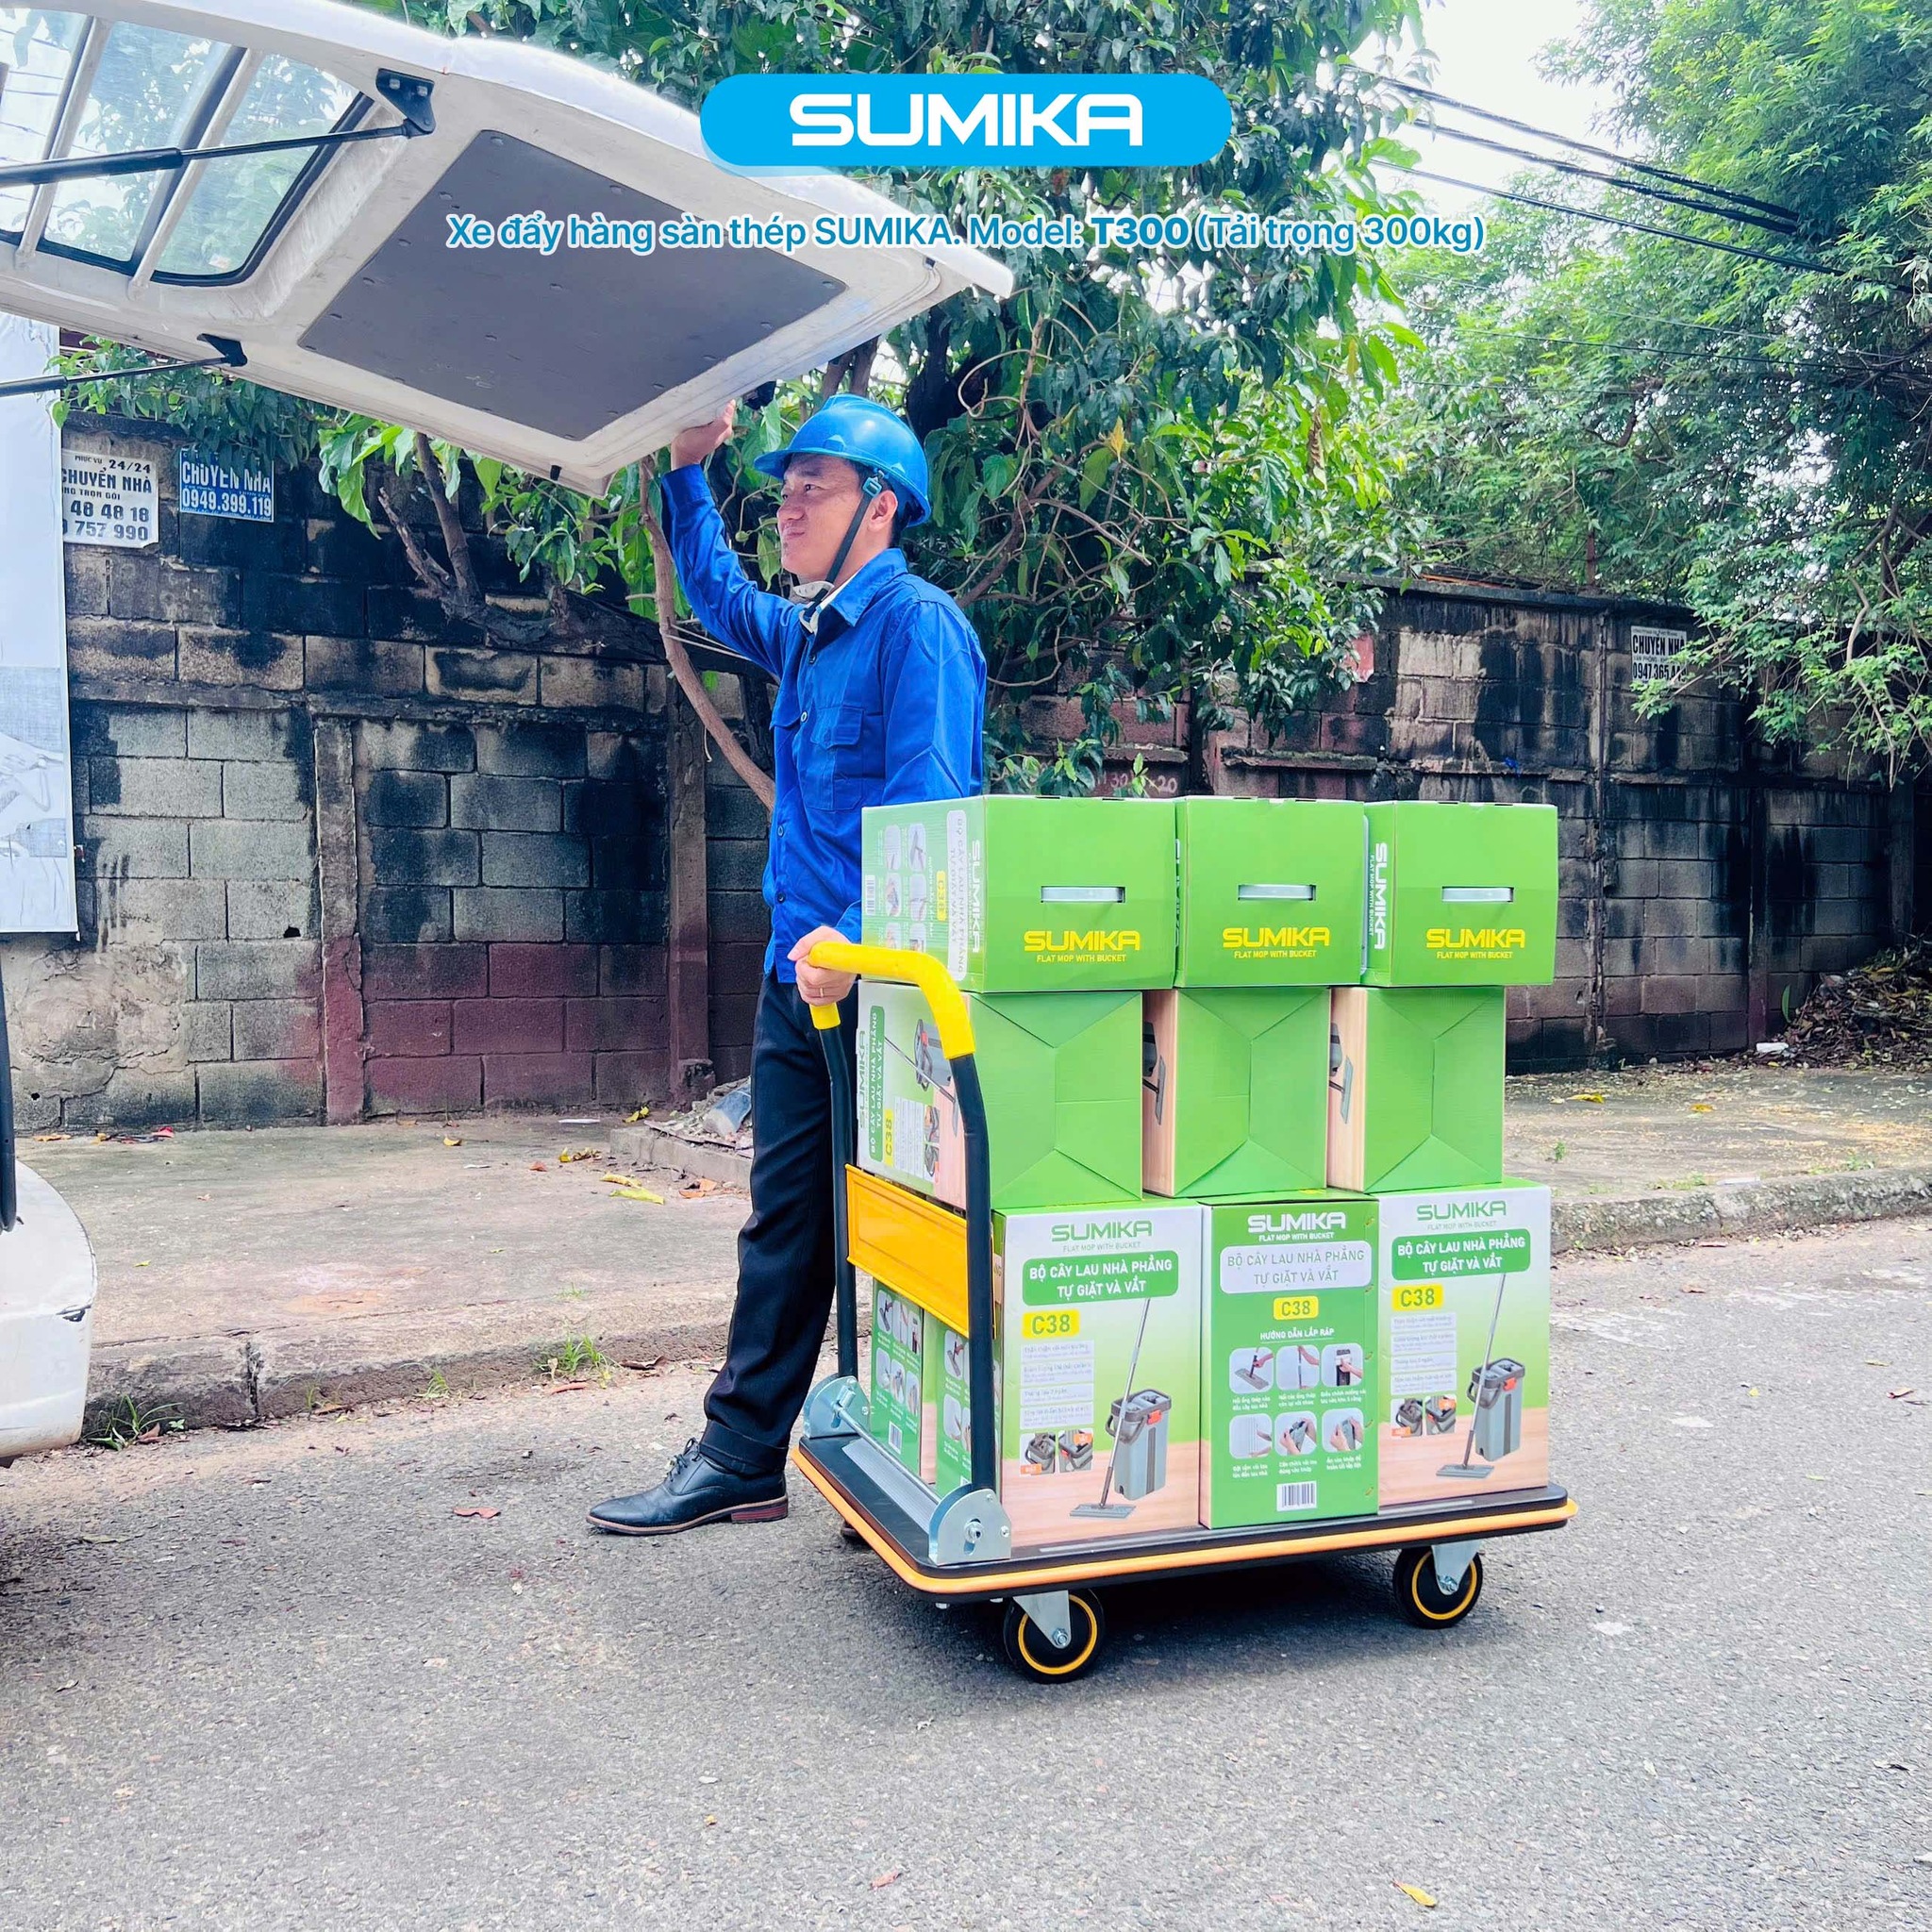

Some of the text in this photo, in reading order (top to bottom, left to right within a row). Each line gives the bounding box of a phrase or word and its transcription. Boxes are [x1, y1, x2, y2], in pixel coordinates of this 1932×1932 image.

[108, 458, 151, 474] 24/24
[123, 475, 152, 493] NHÀ
[70, 500, 150, 523] 48 48 18
[182, 488, 272, 517] 0949.399.119
[113, 524, 149, 541] 990
[972, 840, 981, 953] SUMIKA
[1374, 842, 1388, 950] SUMIKA
[1024, 930, 1141, 952] SUMIKA
[1222, 926, 1330, 948] SUMIKA
[1425, 928, 1525, 949] SUMIKA
[1036, 954, 1127, 962] FLAT MOP WITH BUCKET
[1234, 949, 1317, 959] FLAT MOP WITH BUCKET
[1436, 951, 1454, 959] FLAT
[1454, 951, 1469, 959] MOP
[1416, 1200, 1507, 1221] SUMIKA
[1051, 1220, 1153, 1241] SUMIKA
[1247, 1211, 1346, 1233] SUMIKA
[1397, 1241, 1413, 1258] BỘ
[1416, 1241, 1437, 1255] CÂY
[1440, 1241, 1460, 1253] LAU
[1463, 1237, 1487, 1252] NHÀ
[1227, 1253, 1243, 1270] BỘ
[1246, 1251, 1268, 1265] CÂY
[1271, 1253, 1293, 1265] LAU
[1297, 1248, 1322, 1264] NHÀ
[1423, 1260, 1439, 1275] TỰ
[1441, 1257, 1464, 1274] GIẶT
[1466, 1256, 1481, 1270] VÀ
[1029, 1263, 1046, 1282] BỘ
[1050, 1262, 1074, 1278] CÂY
[1075, 1262, 1099, 1276] LAU
[1103, 1259, 1128, 1274] NHÀ
[1301, 1268, 1315, 1282] VÀ
[1058, 1283, 1074, 1301] TỰ
[1076, 1281, 1104, 1300] GIẶT
[1106, 1279, 1122, 1293] VÀ
[1400, 1288, 1435, 1307] C38
[1281, 1300, 1311, 1317] C38
[1031, 1313, 1072, 1336] C38
